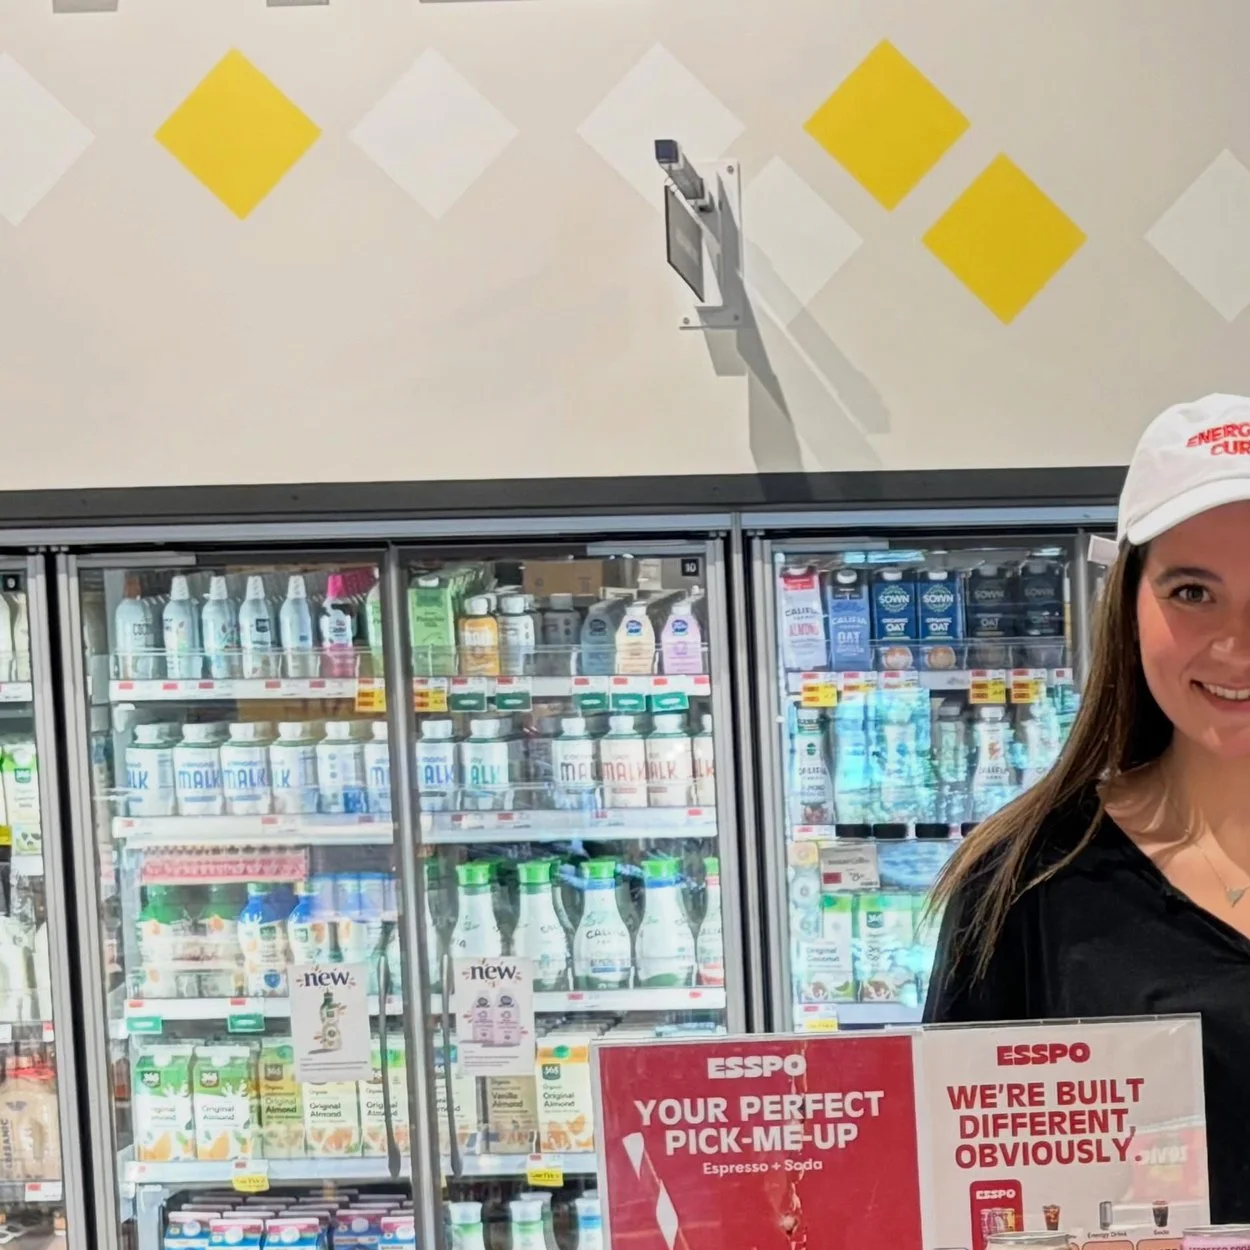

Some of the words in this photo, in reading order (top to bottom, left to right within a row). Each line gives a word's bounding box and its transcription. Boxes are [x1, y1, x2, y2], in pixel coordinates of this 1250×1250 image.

[685, 562, 697, 573] 10
[879, 594, 910, 604] SOWN
[923, 594, 954, 604] SOWN
[885, 623, 906, 632] OAT
[929, 623, 950, 632] OAT
[837, 631, 861, 644] OAT
[178, 770, 221, 789] MALK
[223, 767, 265, 788] MALK
[603, 761, 646, 782] MALK
[304, 970, 350, 987] new
[470, 964, 517, 980] new
[997, 1043, 1090, 1066] ESSPO
[707, 1054, 807, 1080] ESSPO
[542, 1091, 575, 1100] Original
[947, 1082, 1045, 1110] WE'RE
[1057, 1078, 1144, 1106] BUILT
[309, 1101, 341, 1111] Original
[543, 1100, 575, 1108] Almond
[634, 1097, 728, 1126] YOUR
[740, 1090, 884, 1122] PERFECT
[959, 1108, 1136, 1139] DIFFERENT,
[665, 1122, 858, 1156] PICK-ME-UP
[955, 1137, 1143, 1169] OBVIOUSLY.
[703, 1161, 769, 1175] Espresso
[784, 1158, 823, 1173] Soda
[976, 1189, 1016, 1200] ESSPO
